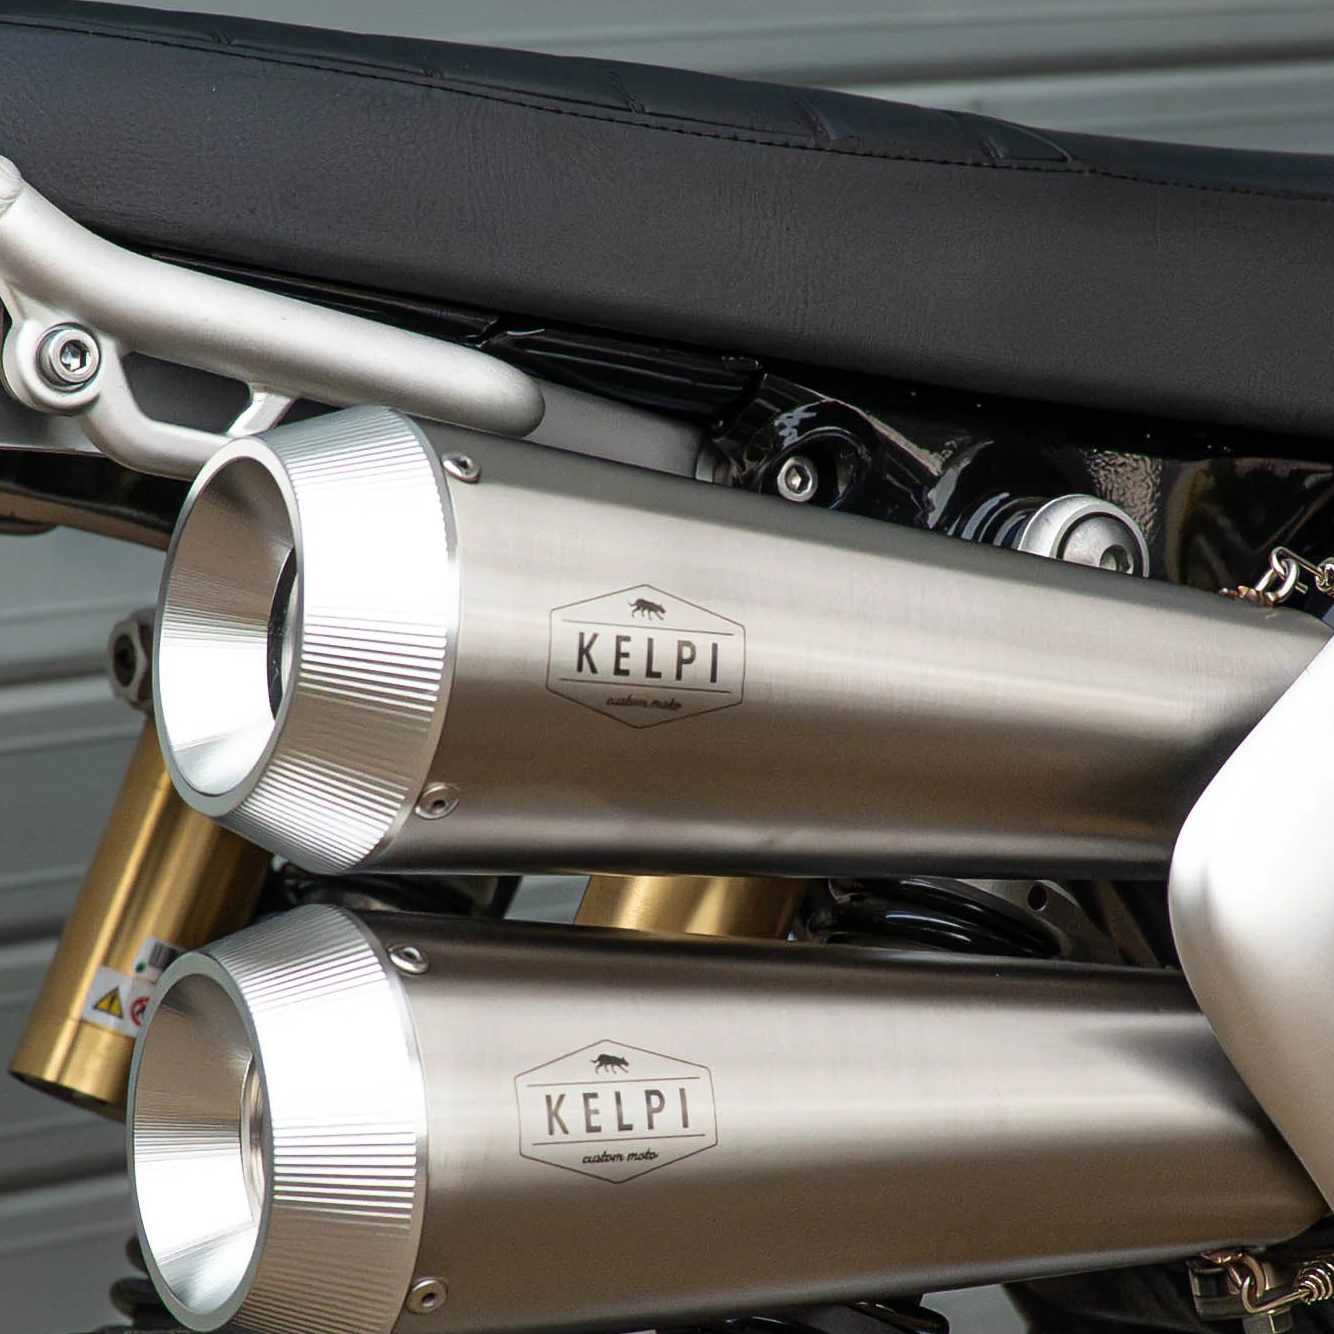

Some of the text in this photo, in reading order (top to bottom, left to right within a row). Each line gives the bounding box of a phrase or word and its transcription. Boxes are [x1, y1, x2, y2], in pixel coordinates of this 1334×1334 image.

[575, 631, 718, 684] KELPI
[545, 1087, 689, 1136] KELPI
[582, 1148, 660, 1164] custom moto
